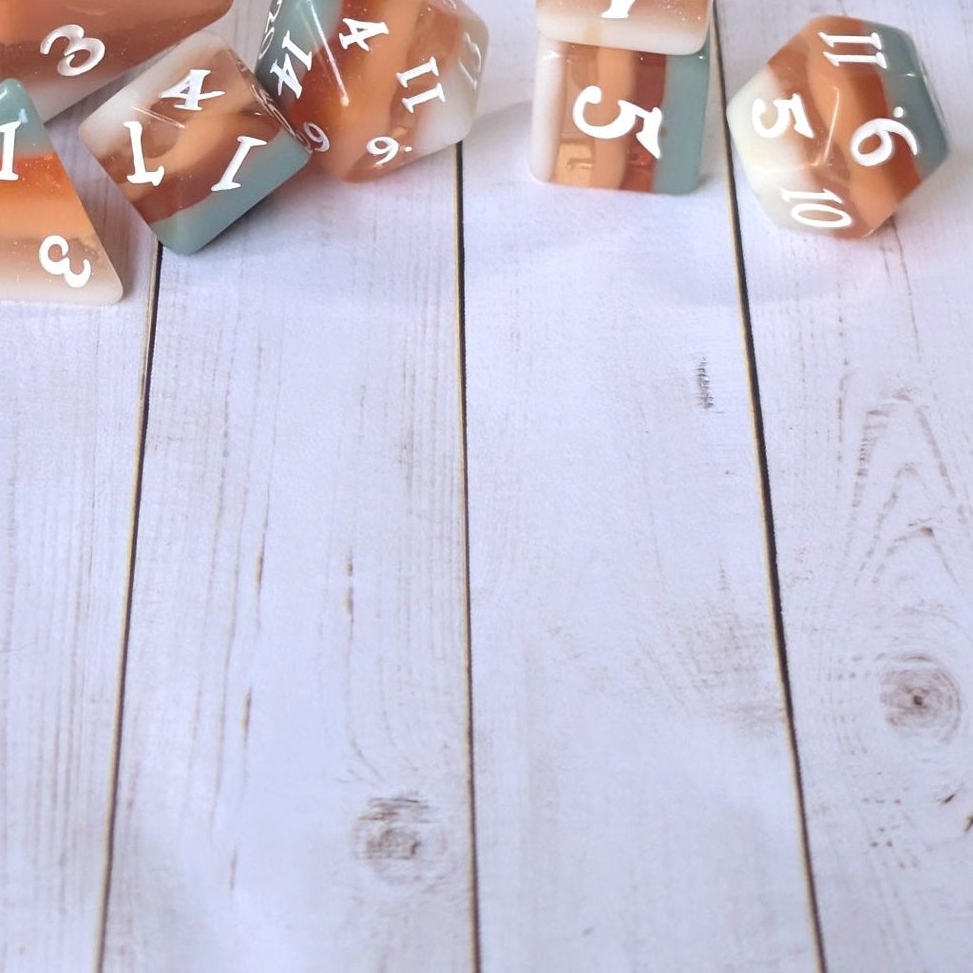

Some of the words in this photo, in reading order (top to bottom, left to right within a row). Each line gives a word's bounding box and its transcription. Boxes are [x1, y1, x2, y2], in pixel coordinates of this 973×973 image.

[40, 24, 105, 76] 3
[338, 17, 389, 51] 4
[818, 32, 887, 69] 11
[160, 69, 226, 111] 4
[270, 30, 312, 99] 14
[396, 56, 446, 114] 11
[573, 85, 662, 160] 5
[752, 93, 814, 139] 5
[211, 136, 268, 191] 1
[781, 188, 852, 227] 10
[39, 235, 91, 288] 3
